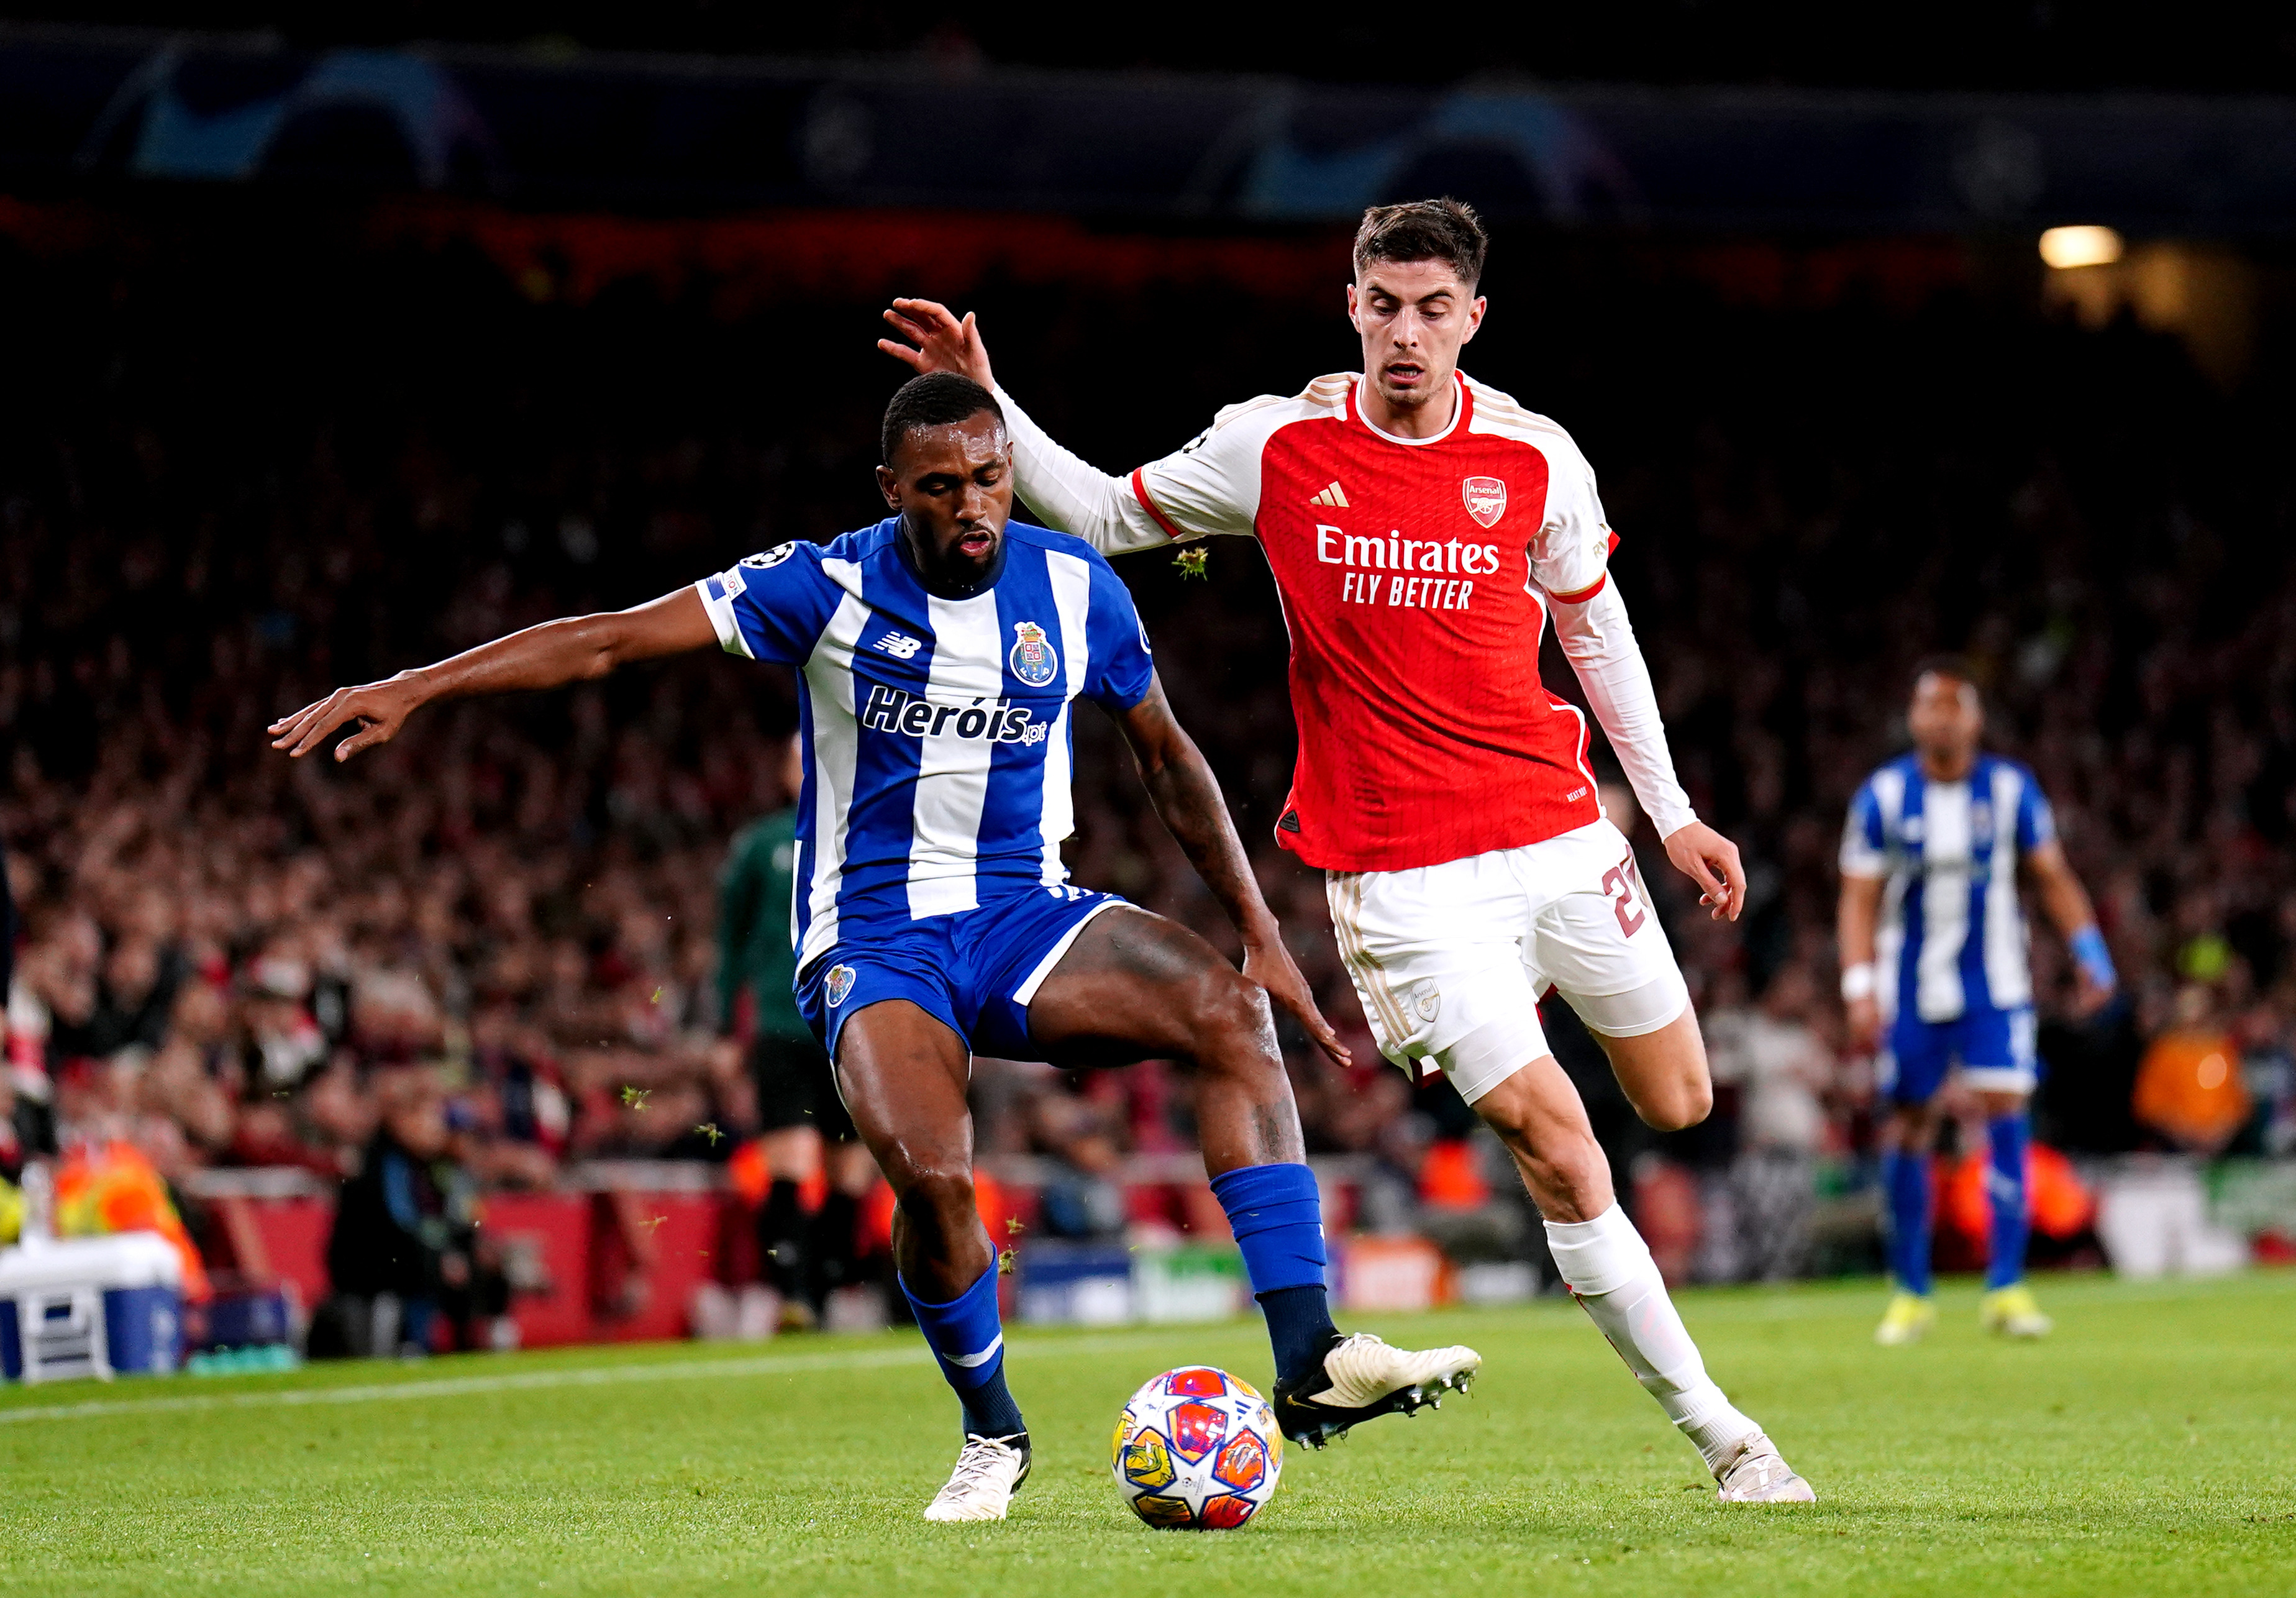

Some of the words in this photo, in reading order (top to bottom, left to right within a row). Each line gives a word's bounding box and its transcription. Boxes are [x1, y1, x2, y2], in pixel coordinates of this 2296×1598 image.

[1469, 485, 1500, 495] Arsenal
[1316, 524, 1500, 575] Emirates
[1342, 572, 1382, 605] FLY
[1388, 576, 1474, 610] BETTER
